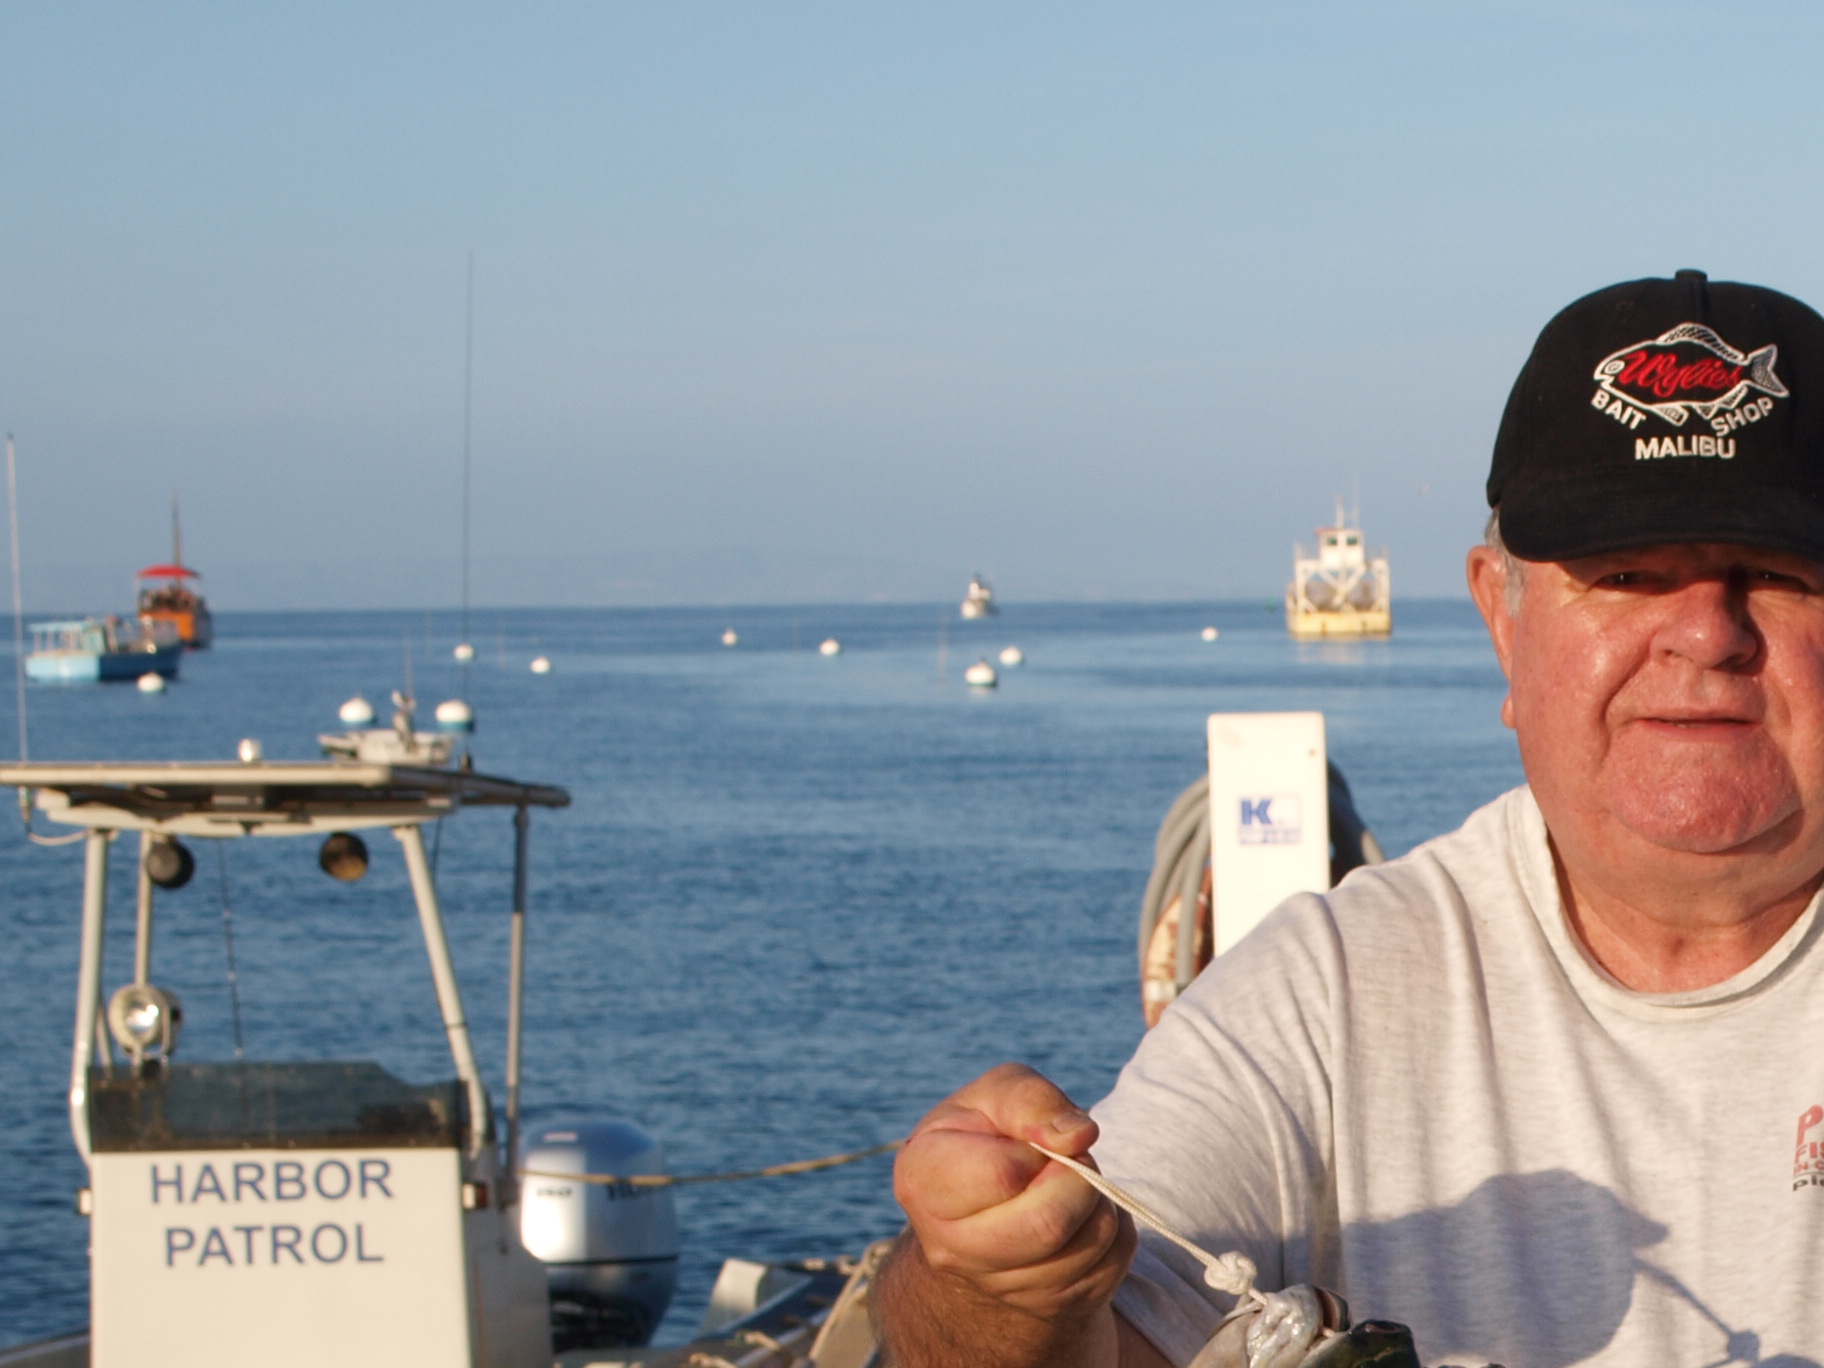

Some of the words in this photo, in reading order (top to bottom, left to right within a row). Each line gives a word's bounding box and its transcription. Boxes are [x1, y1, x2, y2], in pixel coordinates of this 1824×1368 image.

[1591, 390, 1646, 430] BAIT
[1711, 398, 1773, 437] SHOP
[1635, 434, 1736, 460] MALIBU
[151, 1160, 393, 1203] HARBOR
[165, 1223, 384, 1266] PATROL
